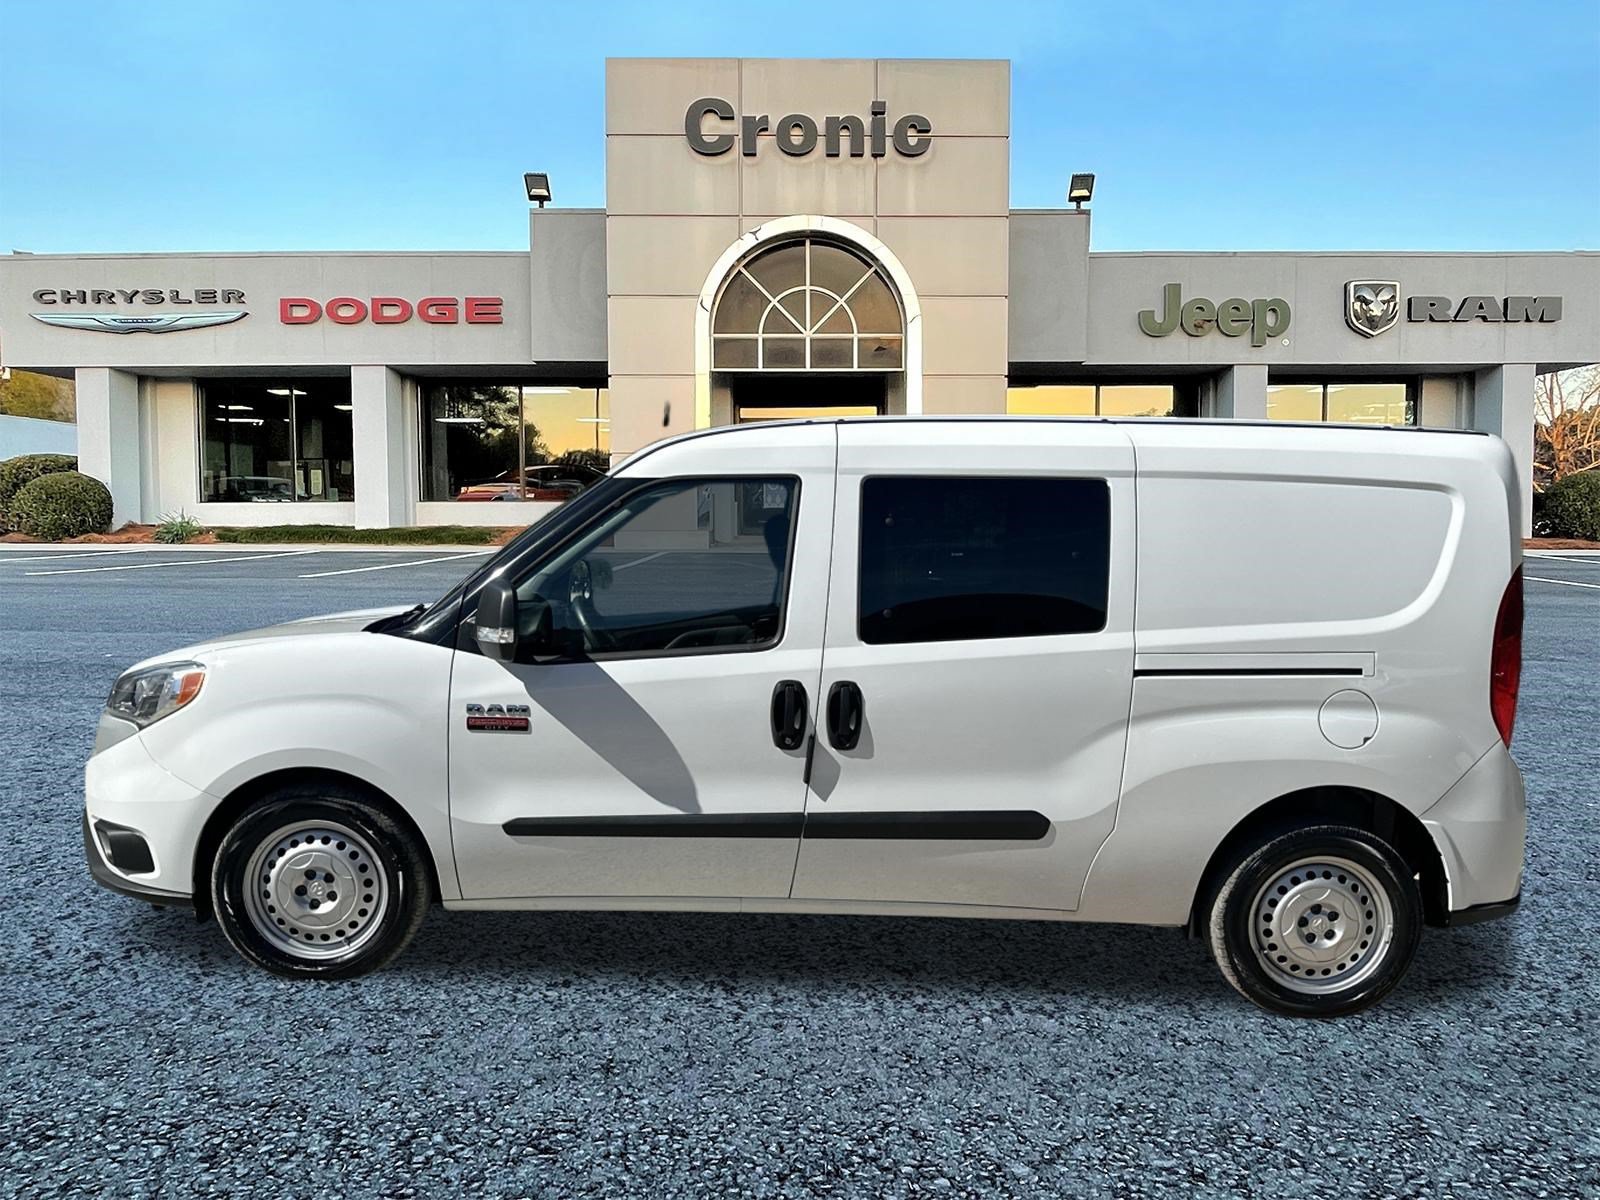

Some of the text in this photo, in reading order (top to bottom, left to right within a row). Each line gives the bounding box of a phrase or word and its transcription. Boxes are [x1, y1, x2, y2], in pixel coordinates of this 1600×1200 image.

[685, 97, 932, 157] Cronic
[33, 289, 246, 304] CHRYSLER
[1407, 296, 1563, 322] RAM
[280, 297, 503, 324] DODGE
[1138, 283, 1292, 346] Jeep
[466, 703, 531, 717] RAM
